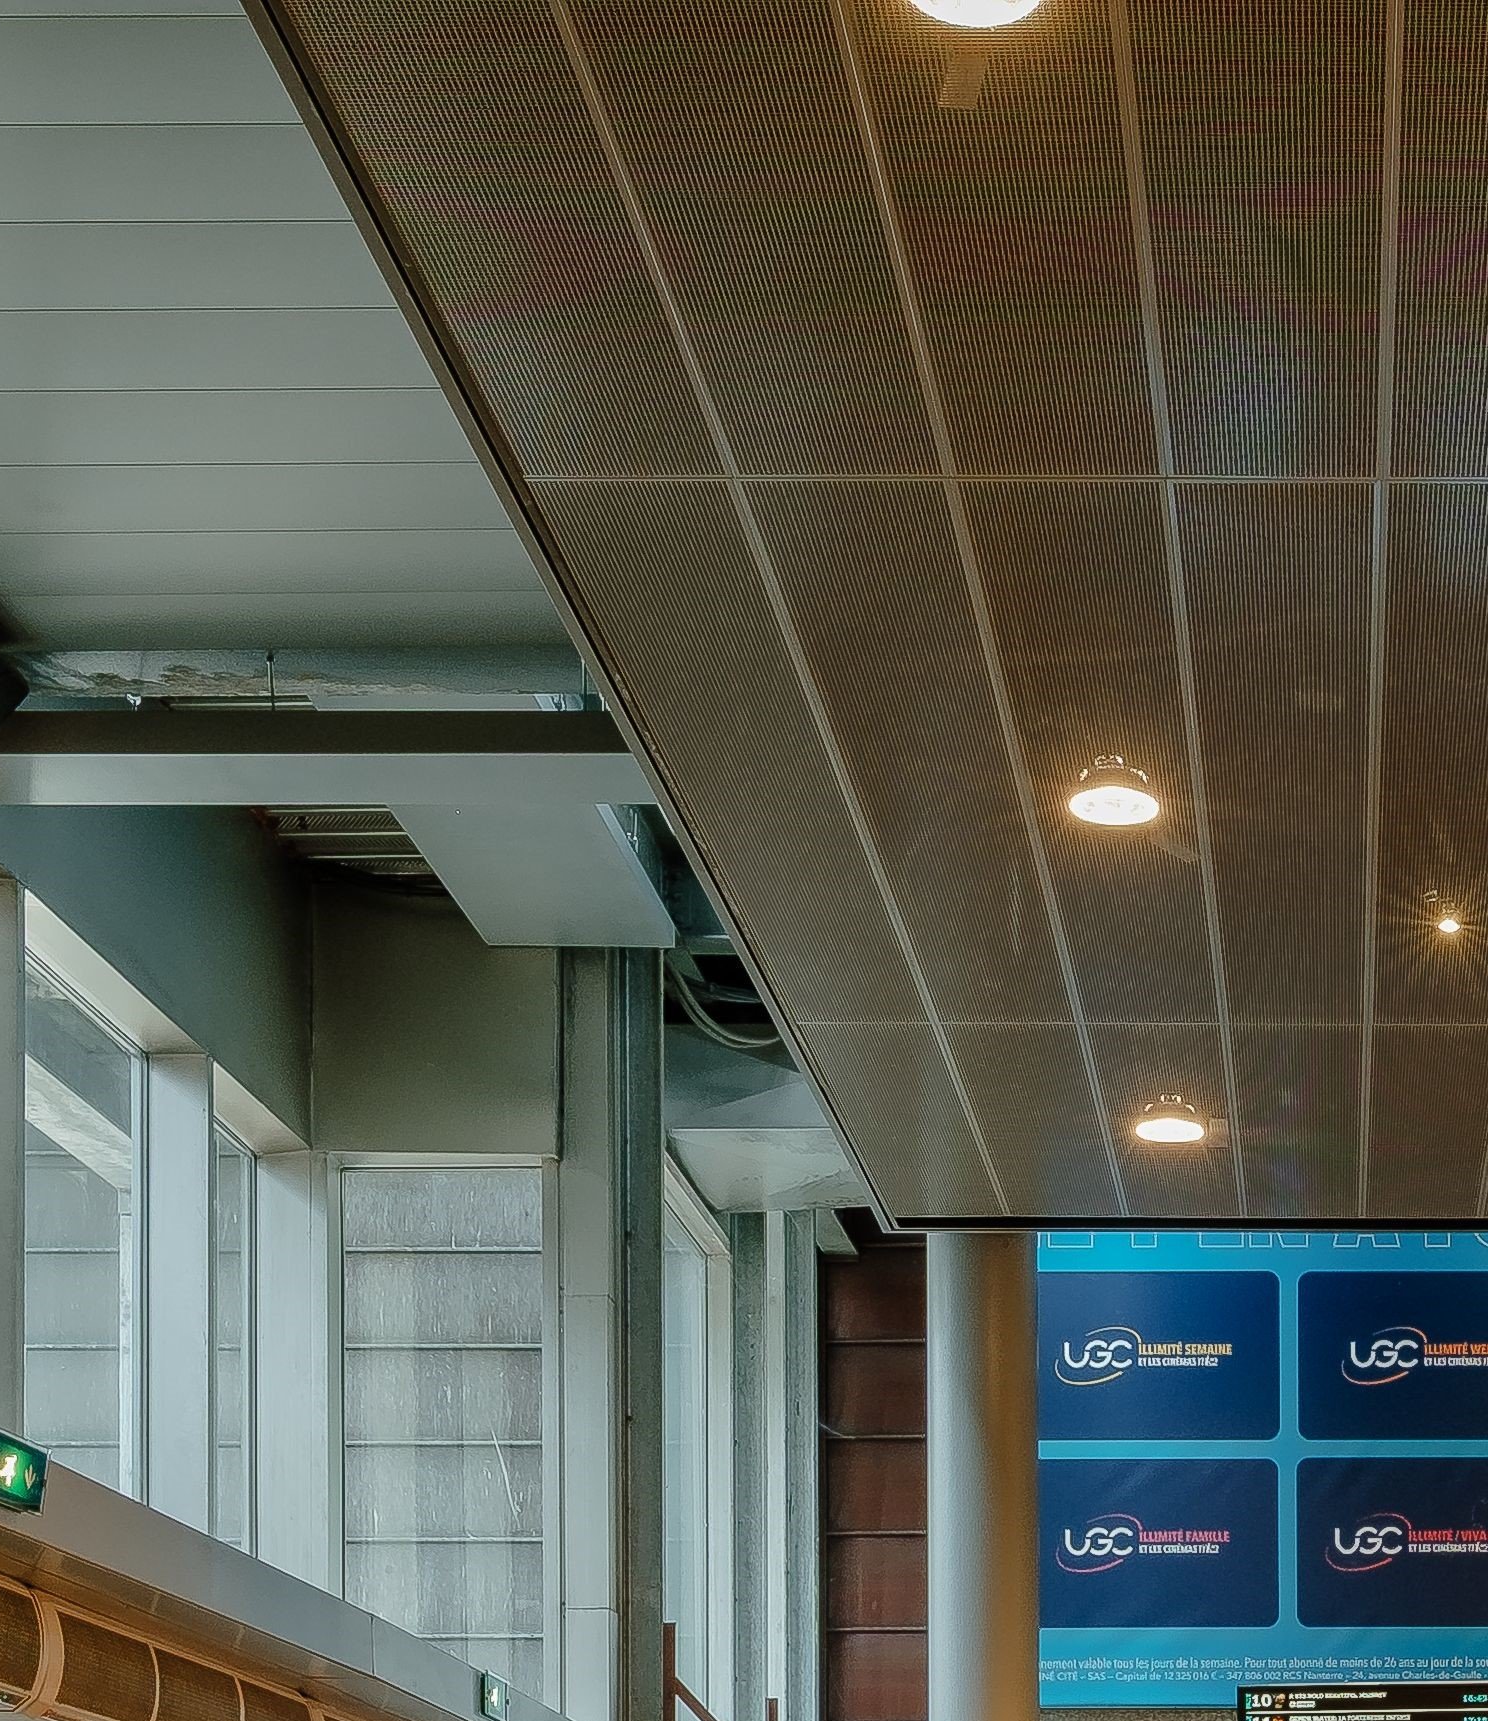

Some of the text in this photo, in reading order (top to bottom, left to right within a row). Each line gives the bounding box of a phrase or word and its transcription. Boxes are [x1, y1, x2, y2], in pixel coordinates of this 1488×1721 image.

[1064, 1339, 1132, 1368] UGC
[1138, 1341, 1232, 1355] ILLIMITÉ SEMAINE
[1350, 1339, 1418, 1368] UGC
[1424, 1341, 1468, 1355] ILLIMITÉ
[1064, 1527, 1133, 1556] UGC
[1138, 1529, 1230, 1543] ILLIMITÉ FAMILLE
[1334, 1526, 1403, 1555] UGC
[1408, 1528, 1453, 1542] ILLIMITÉ
[1461, 1530, 1488, 1541] VIVA
[1252, 1694, 1272, 1708] 10
